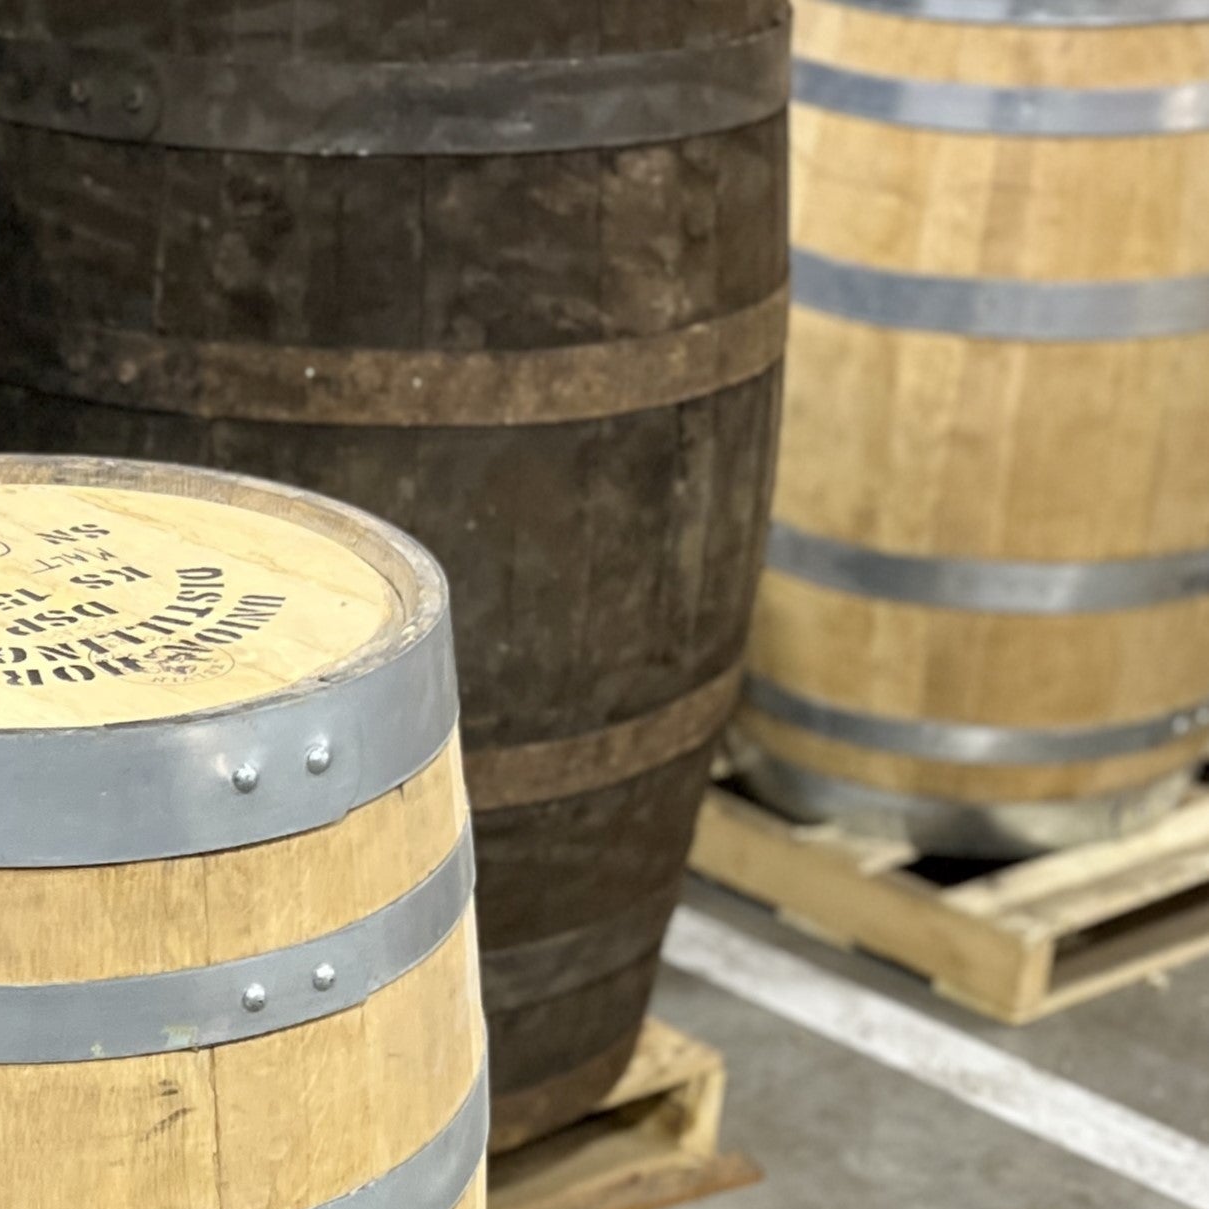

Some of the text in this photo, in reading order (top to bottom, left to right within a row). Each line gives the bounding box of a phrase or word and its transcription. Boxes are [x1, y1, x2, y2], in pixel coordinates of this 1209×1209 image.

[37, 523, 111, 546] SN
[30, 546, 119, 574] MALT
[69, 565, 152, 590] KS
[5, 600, 121, 637] DSP
[167, 594, 287, 653] UNION
